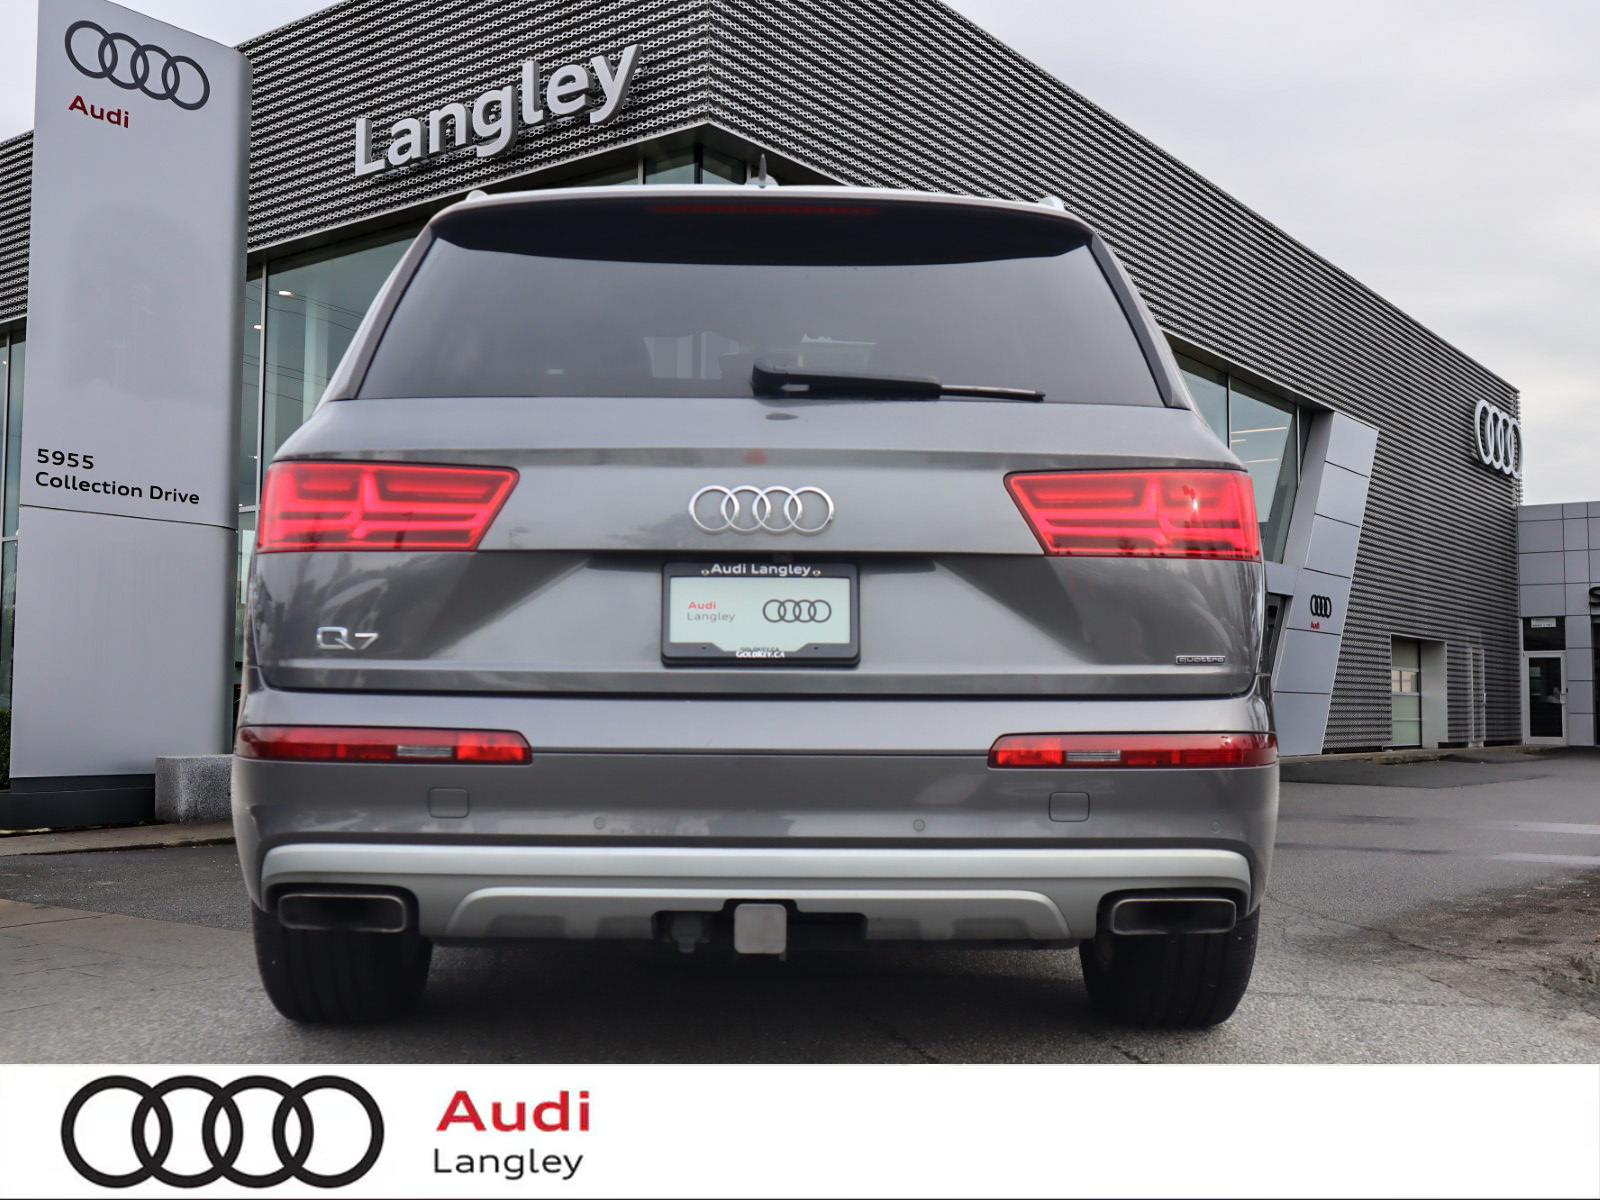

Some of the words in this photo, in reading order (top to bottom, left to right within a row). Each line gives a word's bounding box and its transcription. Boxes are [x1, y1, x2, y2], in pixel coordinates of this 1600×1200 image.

[68, 94, 129, 129] Audi
[355, 44, 643, 177] Langley
[37, 448, 94, 470] 5955
[35, 471, 143, 498] Collection
[149, 485, 200, 505] Drive
[710, 563, 747, 575] Audi
[750, 563, 812, 577] Langley
[687, 601, 717, 610] Audi
[686, 612, 736, 623] Langley
[316, 626, 379, 650] Q7
